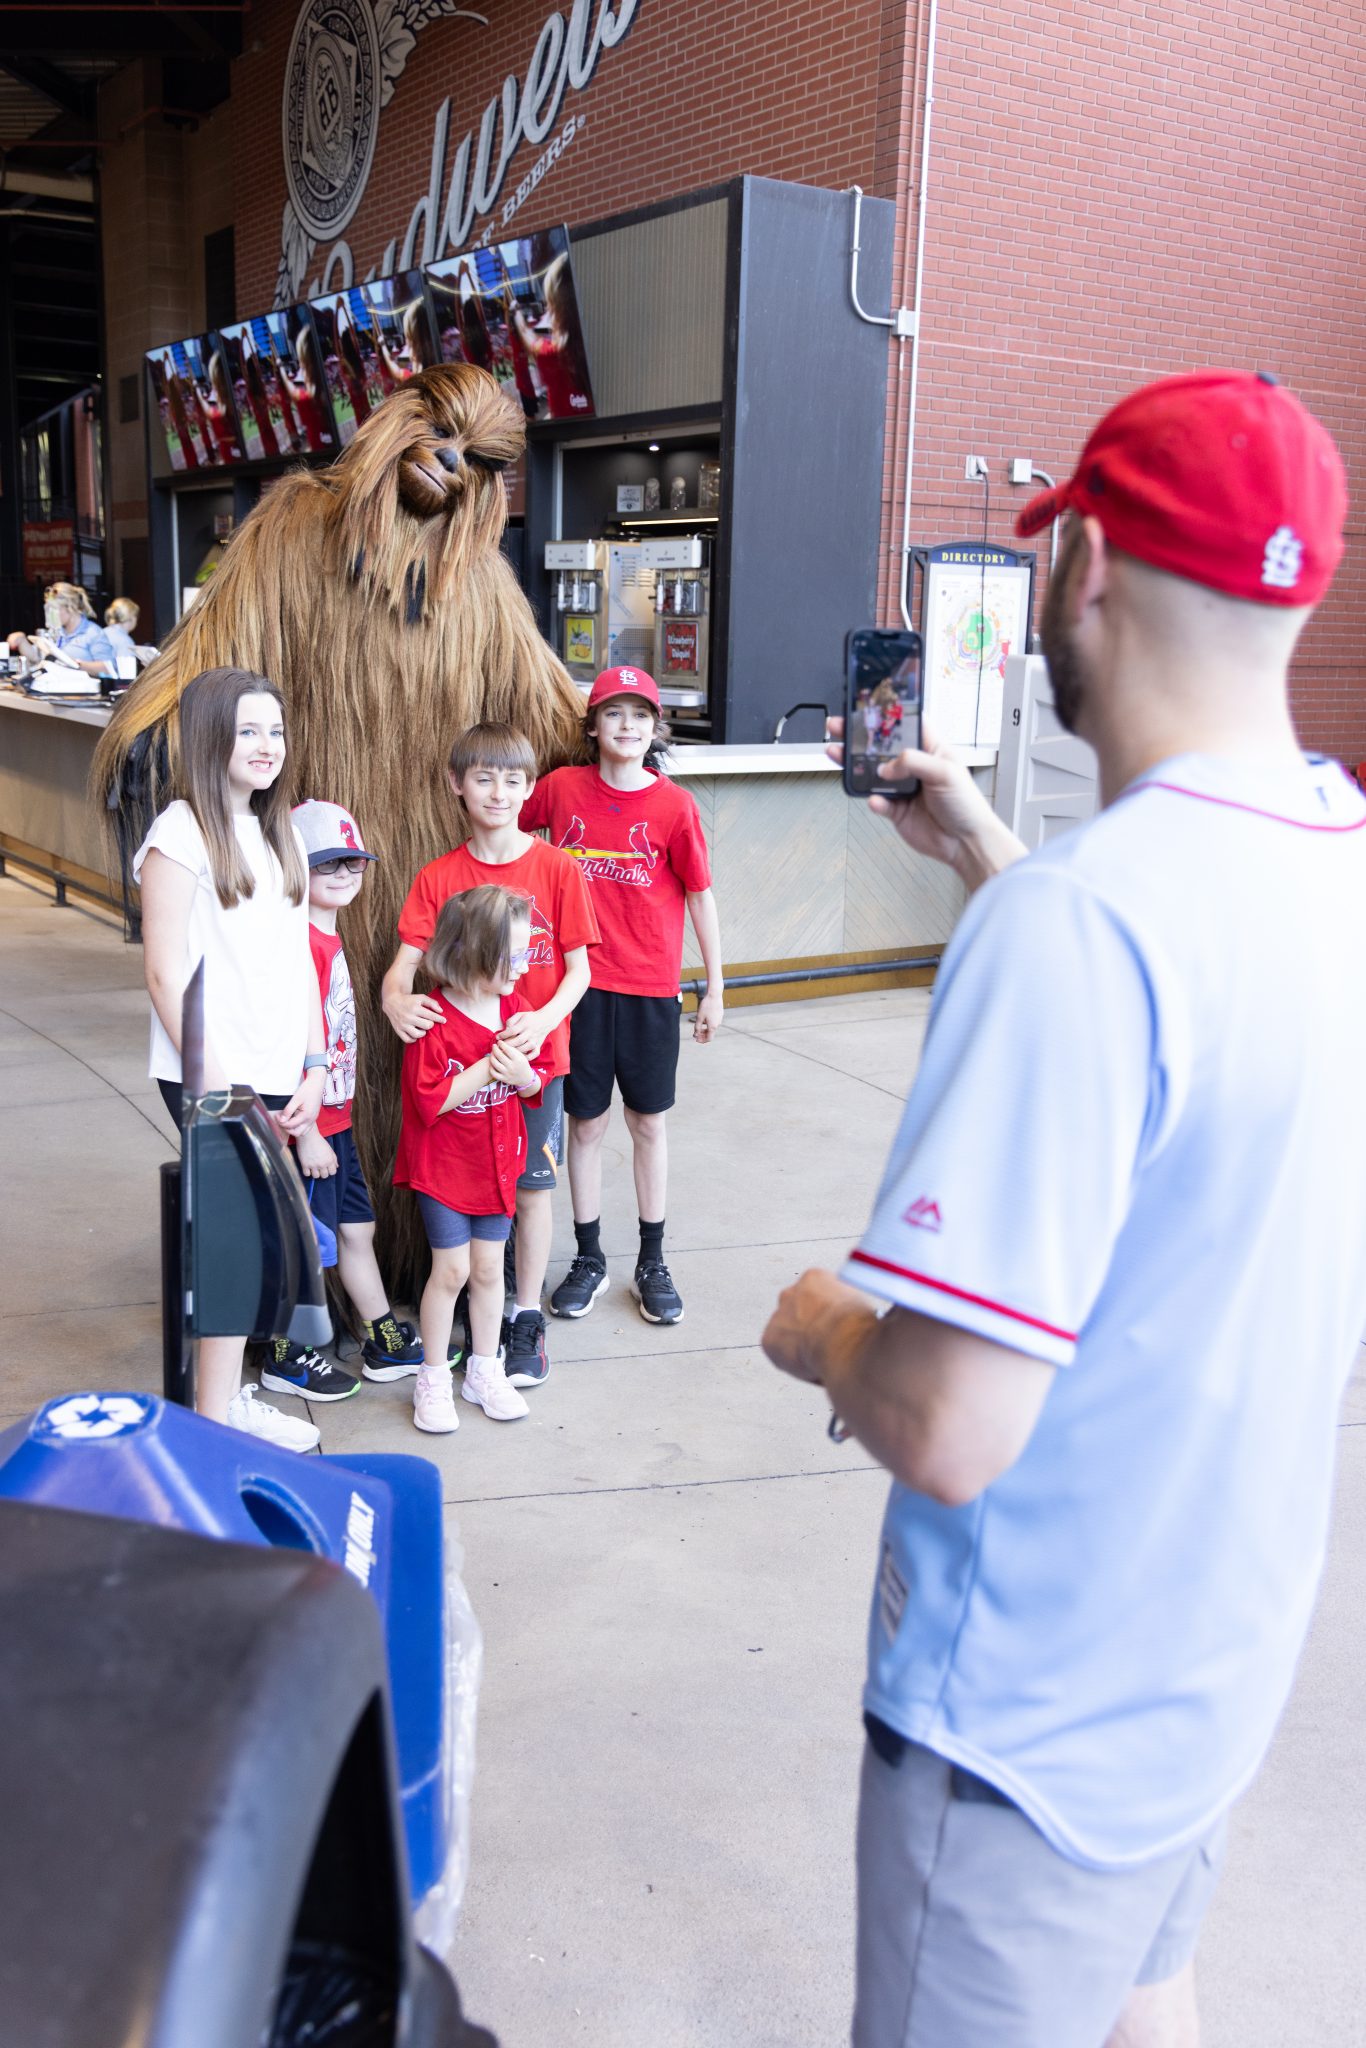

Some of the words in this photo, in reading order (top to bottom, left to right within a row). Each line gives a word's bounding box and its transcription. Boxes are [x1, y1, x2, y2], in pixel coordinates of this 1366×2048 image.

[942, 552, 1006, 564] DIRECTORY
[1012, 708, 1021, 727] 9
[578, 857, 652, 887] ardinals
